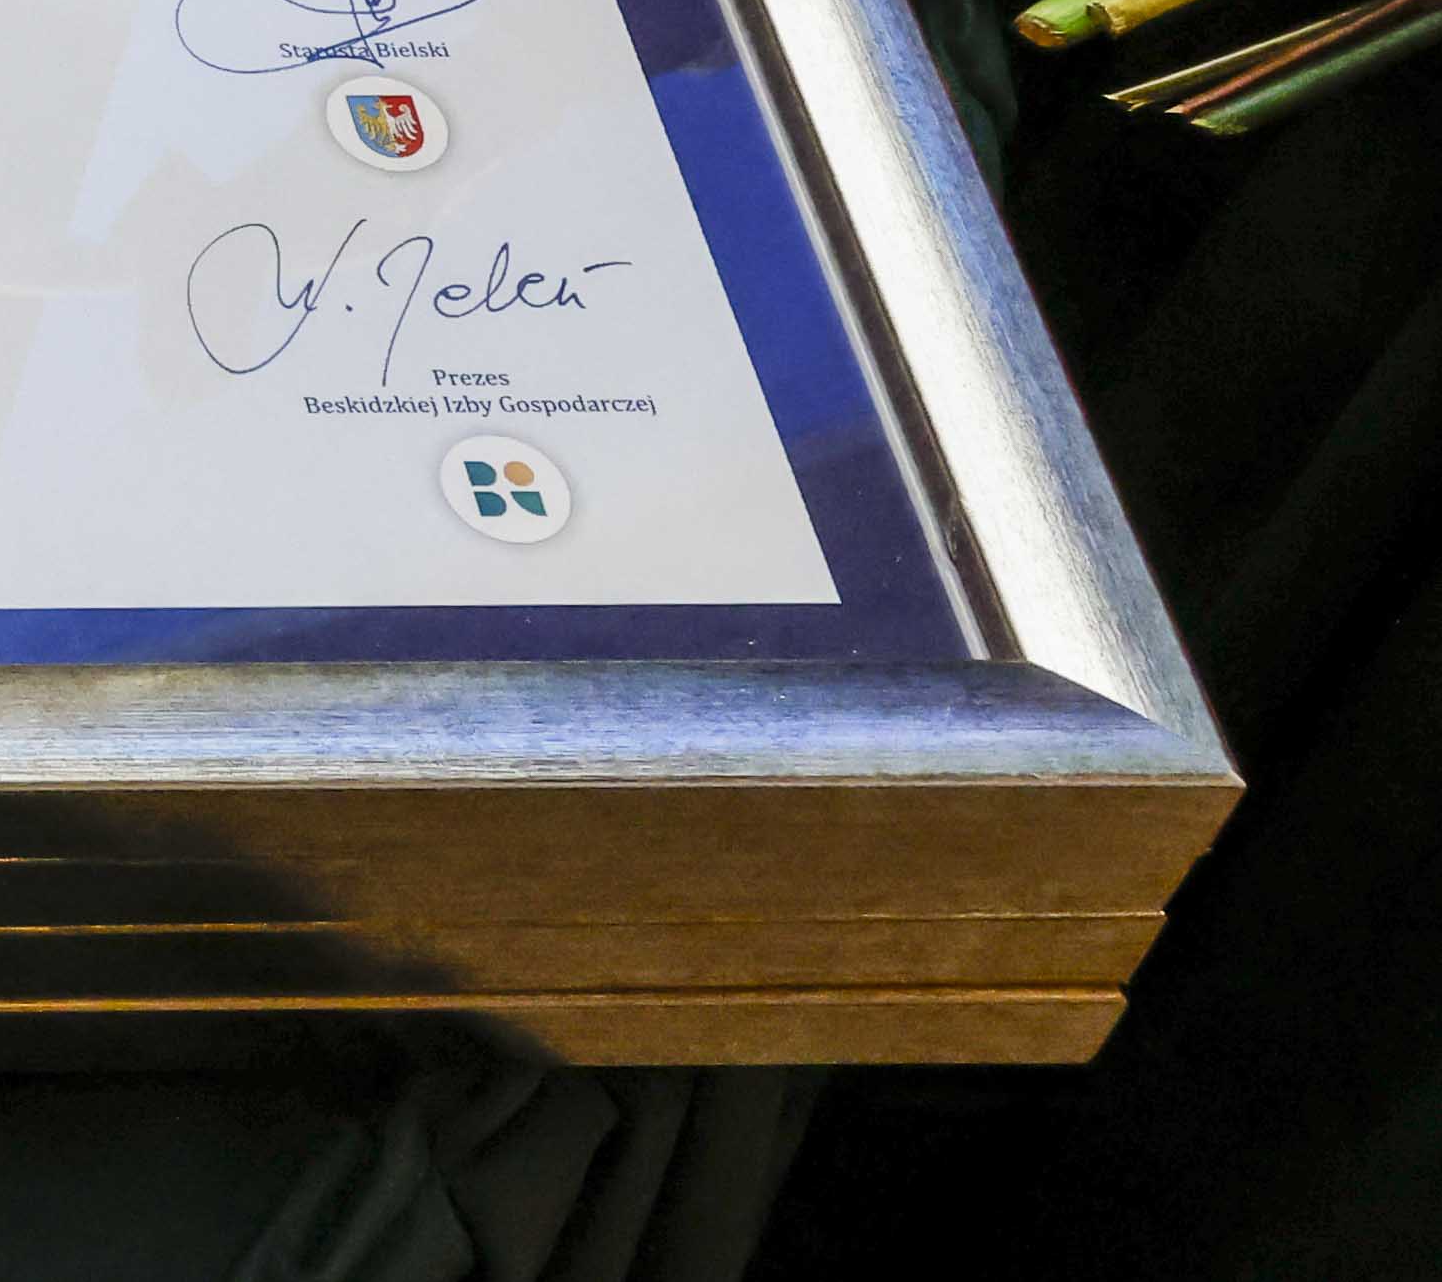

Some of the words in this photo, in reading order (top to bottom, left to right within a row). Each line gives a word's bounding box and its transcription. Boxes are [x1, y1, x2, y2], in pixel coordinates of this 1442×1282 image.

[373, 40, 450, 59] Bielski
[431, 369, 510, 387] Prezes
[303, 395, 439, 418] Beskidzkiej
[442, 394, 492, 418] Izby
[498, 394, 657, 418] Gospodarczej
